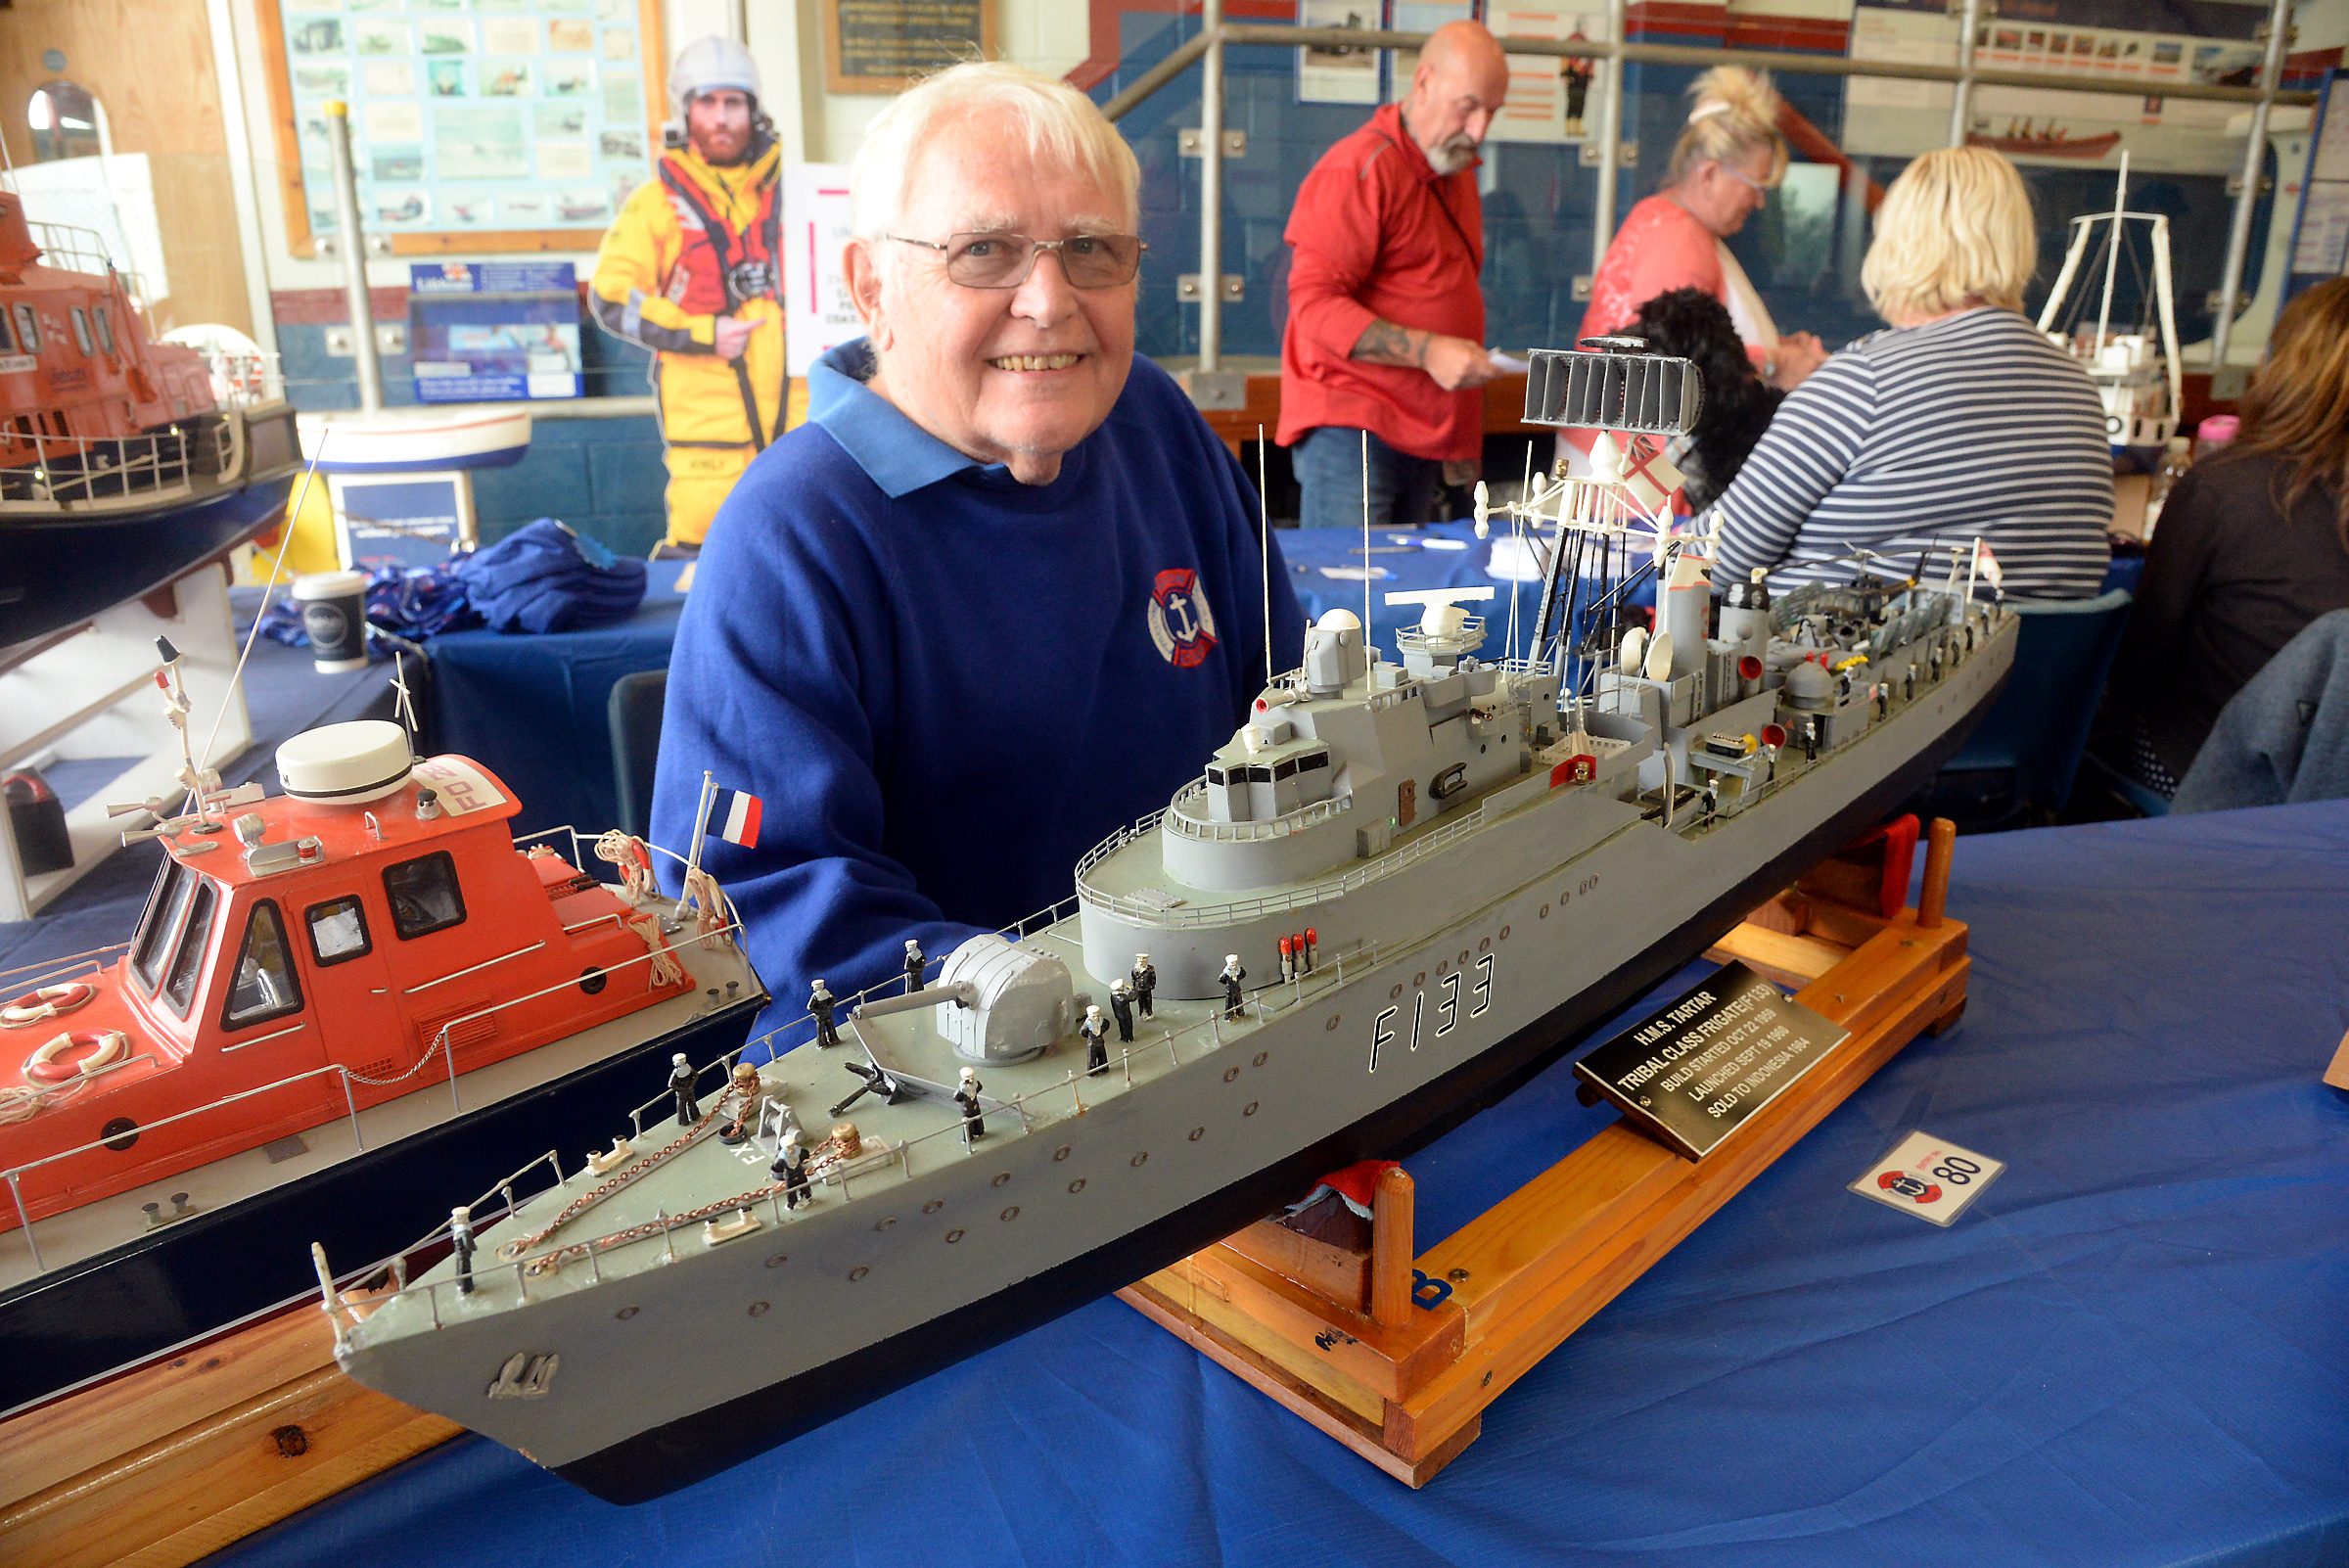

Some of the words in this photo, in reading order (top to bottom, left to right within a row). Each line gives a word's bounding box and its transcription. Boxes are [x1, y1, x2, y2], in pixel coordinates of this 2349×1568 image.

[443, 780, 487, 811] FO
[1368, 952, 1496, 1074] F133
[1633, 1020, 1677, 1046] H.M.S.
[1666, 991, 1717, 1024] TARTAR
[1617, 1056, 1671, 1091] TRIBAL
[1662, 1031, 1705, 1060] CLASS
[1660, 1066, 1694, 1092] BUILD
[1688, 1040, 1731, 1072] STARTED
[1726, 1027, 1749, 1045] OCT
[1743, 1020, 1760, 1034] 22
[1754, 1008, 1776, 1025] 1959
[1687, 1061, 1741, 1102] LAUNCHED
[1734, 1044, 1762, 1066] SEPT
[1757, 1038, 1773, 1050] 19
[1767, 1025, 1790, 1042] 1960
[1707, 1092, 1738, 1118] SOLD
[1731, 1083, 1751, 1097] TO
[1744, 1050, 1795, 1087] INDONESIA
[1787, 1037, 1811, 1054] 1984
[729, 1142, 765, 1165] FX
[1932, 1156, 1981, 1185] 80
